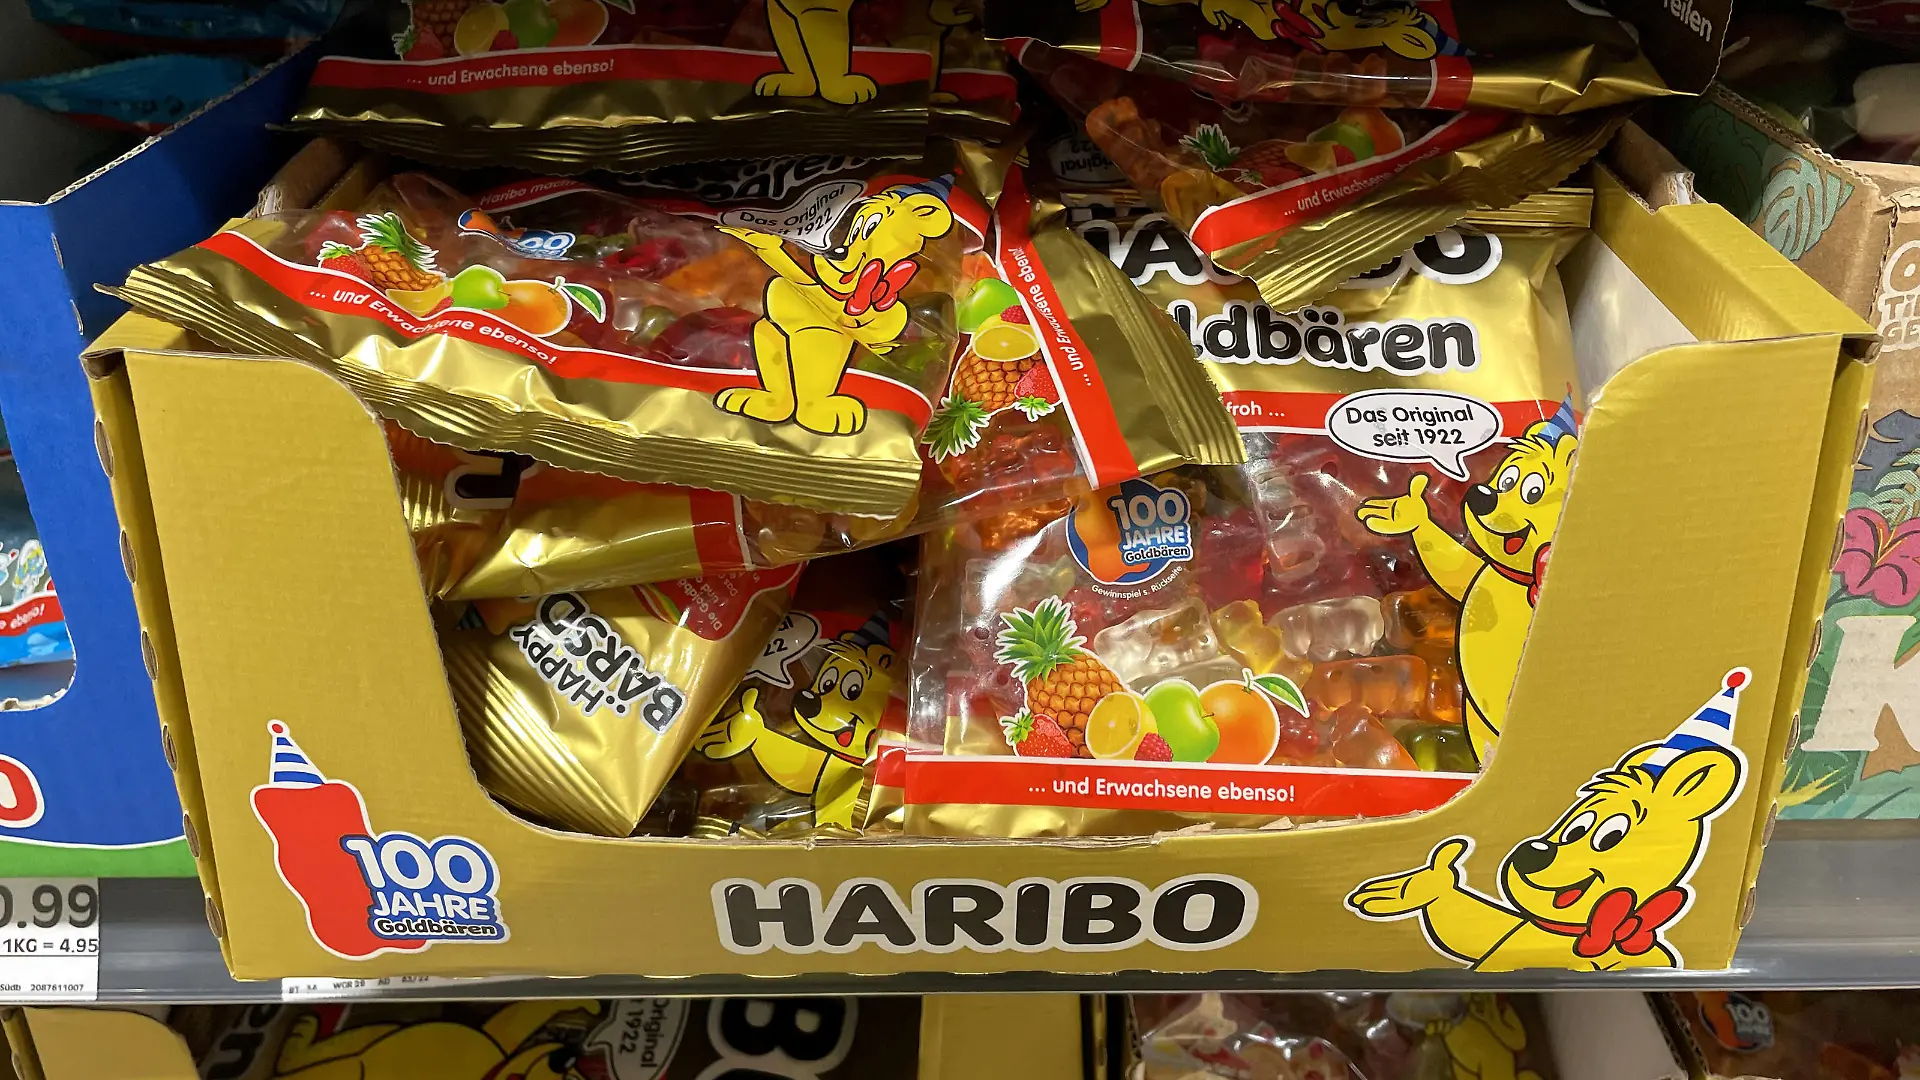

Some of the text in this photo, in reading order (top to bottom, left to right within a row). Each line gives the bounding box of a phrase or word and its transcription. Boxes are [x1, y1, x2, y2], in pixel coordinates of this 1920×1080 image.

[428, 71, 456, 85] und
[461, 64, 548, 83] Erwachsene
[553, 59, 614, 75] ebenso!
[1060, 153, 1112, 175] riginal
[480, 188, 526, 206] Haribo
[739, 184, 846, 226] Das Original
[1297, 191, 1322, 211] und
[796, 207, 832, 236] 1922
[333, 289, 370, 304] und
[479, 325, 557, 365] ebenso!
[1174, 302, 1477, 372] ldbären
[1059, 345, 1084, 371] und
[1227, 401, 1262, 417] froh
[1346, 404, 1474, 426] Das Original
[1372, 428, 1465, 447] seit 1922
[1111, 492, 1185, 529] 100
[1123, 526, 1185, 550] JAHRE
[1125, 546, 1188, 562] Goldbären
[1092, 584, 1142, 600] Gewinnspiel
[1151, 566, 1183, 593] Rückseite
[513, 625, 604, 713] HAPPY
[540, 593, 684, 732] BÄRSD
[1053, 777, 1089, 795] und
[1096, 779, 1212, 799] Erwachsene
[1218, 781, 1295, 802] ebenso!
[346, 839, 487, 894] 100
[373, 891, 490, 920] JAHRE
[724, 879, 1246, 948] HARIBO
[377, 919, 496, 935] Goldbären
[3, 938, 37, 953] 1KG
[60, 938, 99, 953] 4.95
[0, 983, 21, 992] Südb
[619, 1009, 643, 1056] 1922
